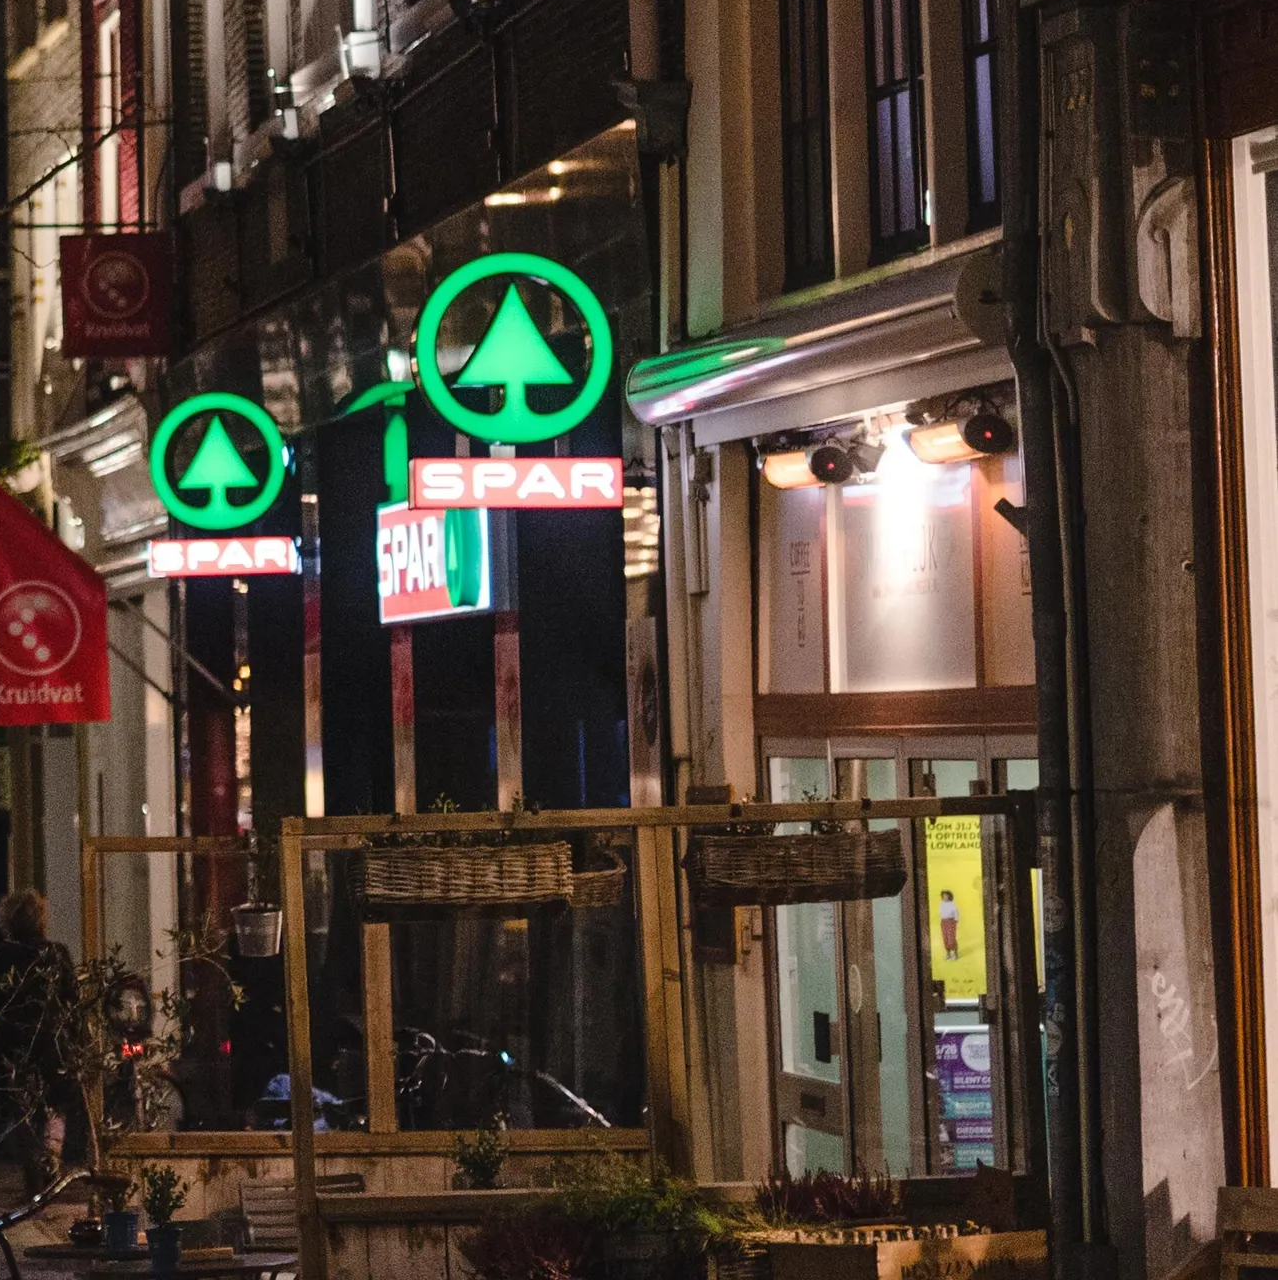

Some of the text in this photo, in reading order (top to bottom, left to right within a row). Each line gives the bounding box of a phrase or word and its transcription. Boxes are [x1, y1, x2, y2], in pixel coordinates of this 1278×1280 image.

[422, 463, 615, 499] SPAR
[153, 540, 287, 571] SPAR
[377, 516, 439, 597] SPAR
